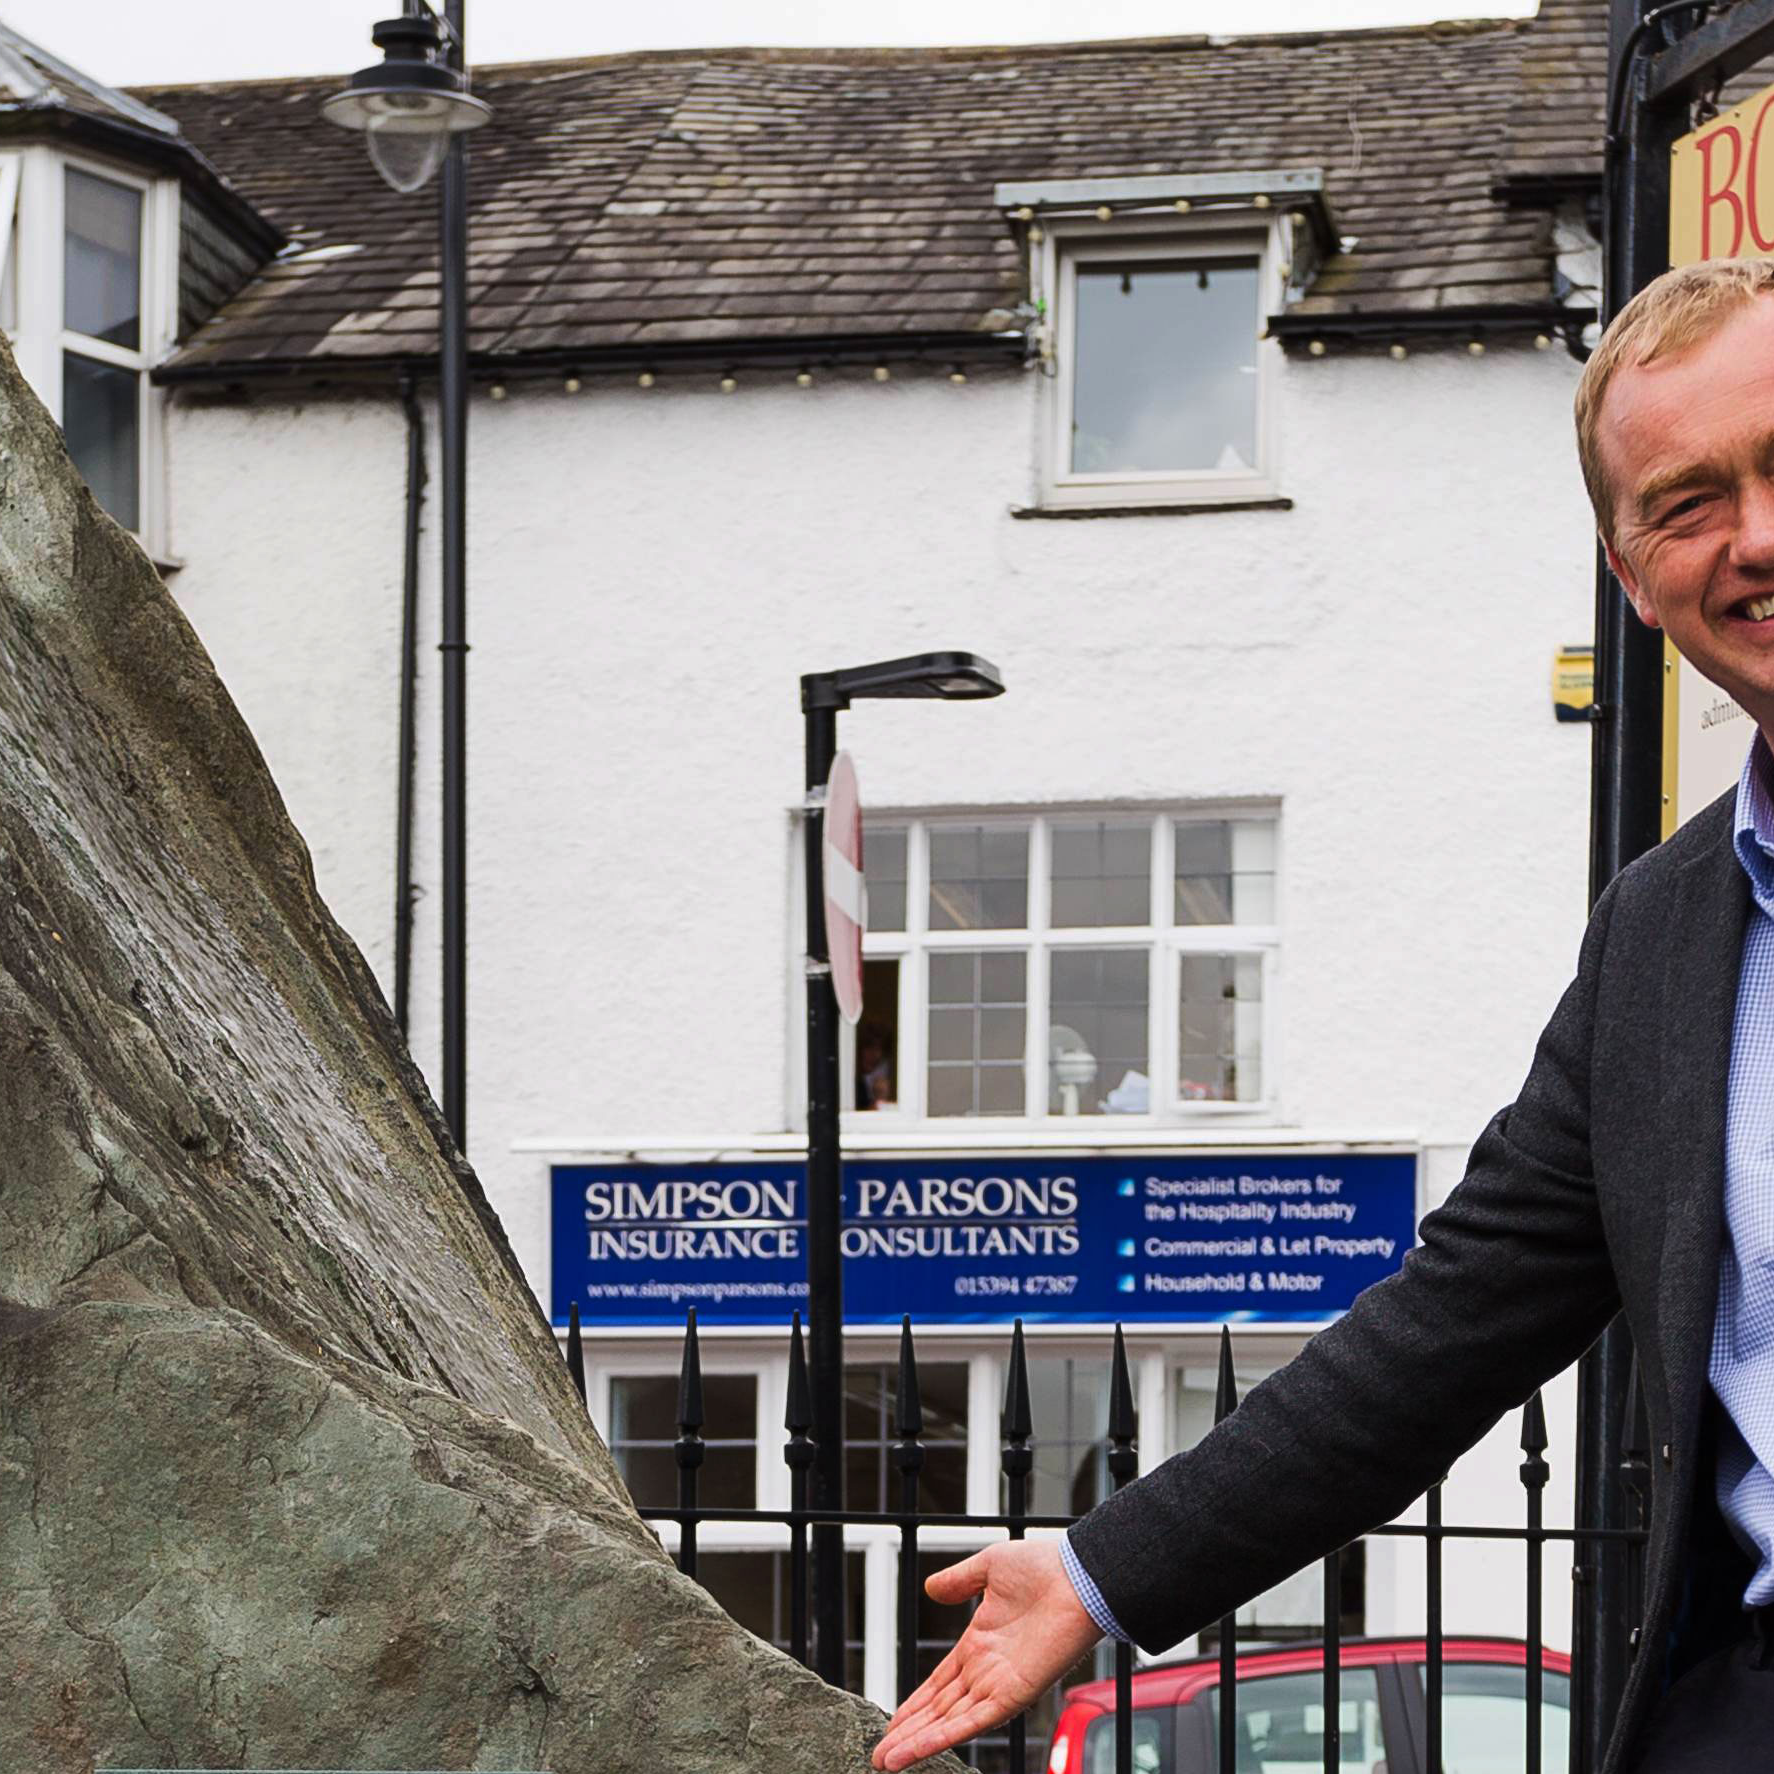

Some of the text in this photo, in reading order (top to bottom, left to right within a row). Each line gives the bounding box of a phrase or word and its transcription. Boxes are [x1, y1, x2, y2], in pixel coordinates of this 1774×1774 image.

[1144, 1174, 1343, 1198] Specialist Brokers for
[584, 1177, 1078, 1221] SIMPSON PARSONS
[1144, 1200, 1357, 1224] the Hospitality Industry
[587, 1225, 1080, 1260] INSURANCE ONSULTANTS
[1144, 1235, 1396, 1259] Commercial & Let Property
[587, 1279, 810, 1303] www.simpsonparsons.co
[954, 1275, 1078, 1296] 015394 47387
[1144, 1271, 1324, 1292] Household & Motor
